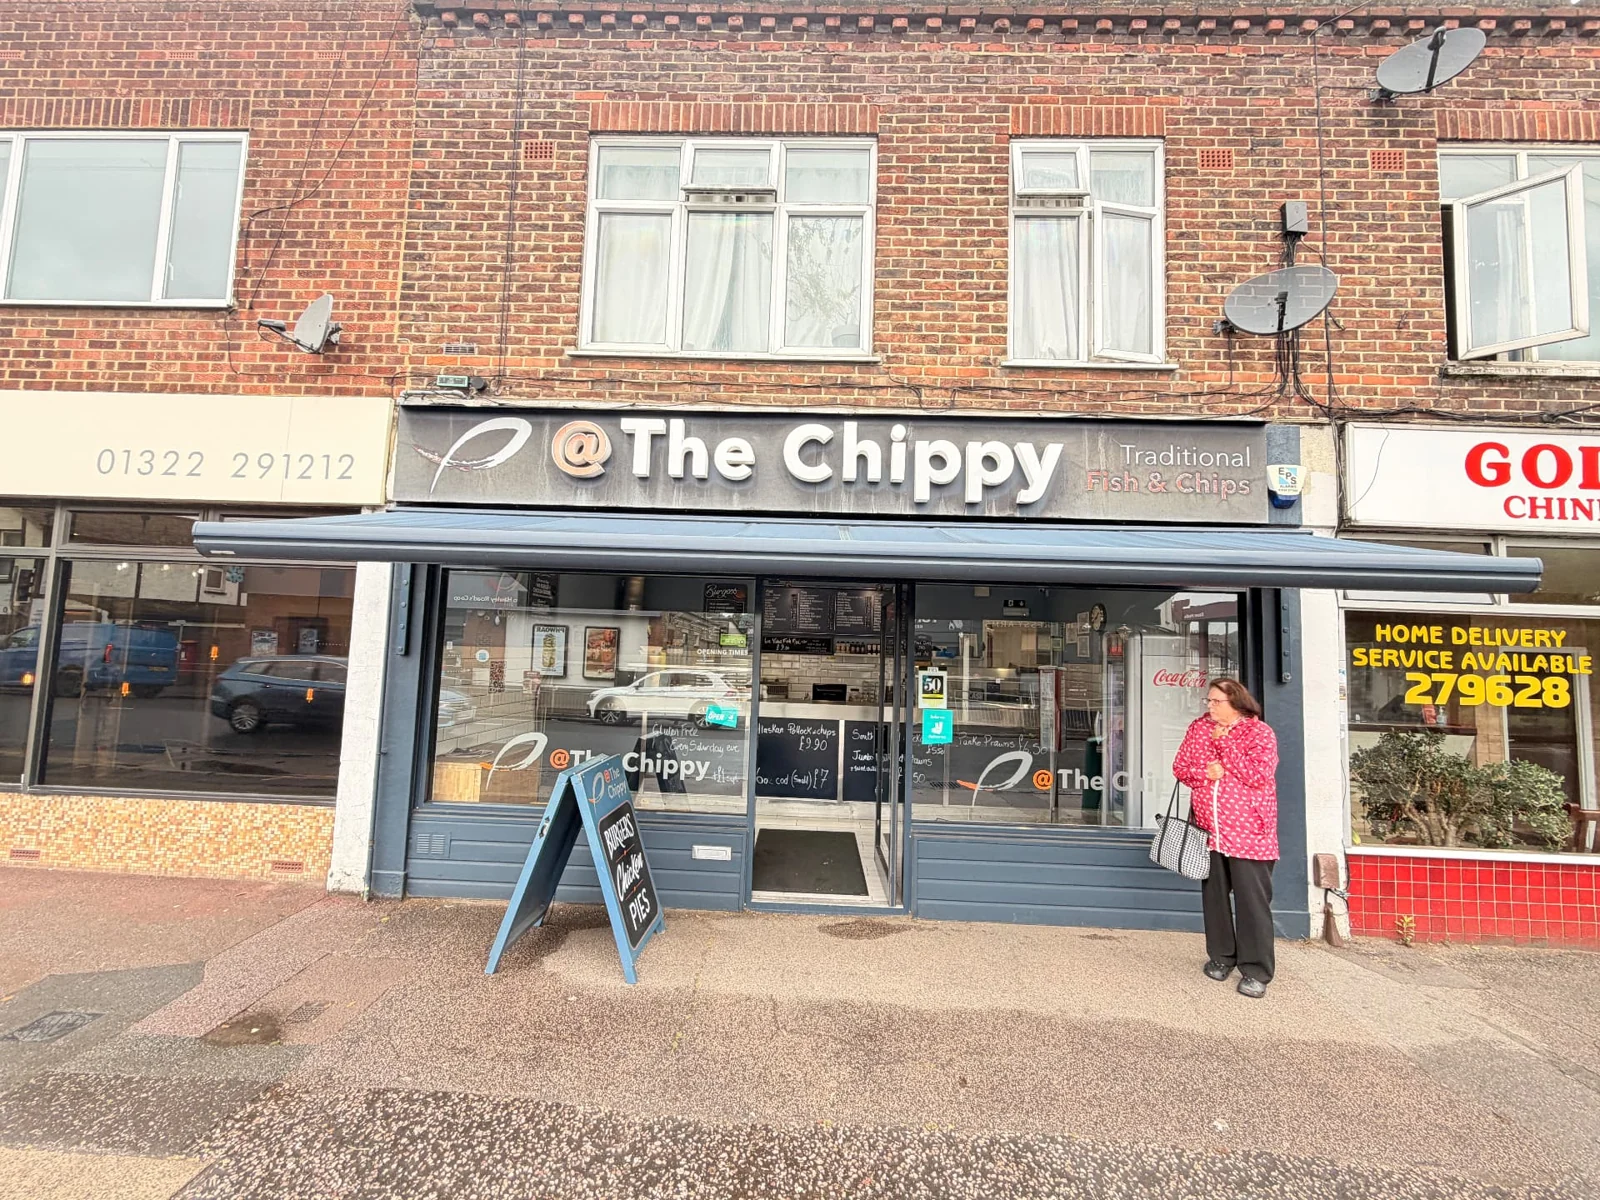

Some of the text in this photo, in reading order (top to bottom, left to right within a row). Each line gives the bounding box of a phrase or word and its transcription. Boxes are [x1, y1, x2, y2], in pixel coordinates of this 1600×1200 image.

[96, 448, 356, 480] 01322 291212
[782, 421, 1064, 505] Chippy
[1119, 443, 1251, 468] Traditional
[1086, 470, 1251, 499] Fish & Chips
[1503, 495, 1600, 521] CHIN
[705, 584, 738, 598] Burgers
[1375, 624, 1566, 648] HOME DELIVERY
[1353, 648, 1593, 675] SERVICE AVAILABLE
[1404, 672, 1571, 708] 279628
[681, 723, 699, 737] Free
[799, 735, 828, 751] £9.90
[983, 735, 1015, 748] Prawns
[622, 751, 710, 781] Chippy
[608, 780, 627, 799] Chippy
[775, 774, 789, 785] cod
[603, 812, 635, 860] BURGERS
[616, 852, 644, 901] Chicken
[628, 888, 651, 931] PIES
